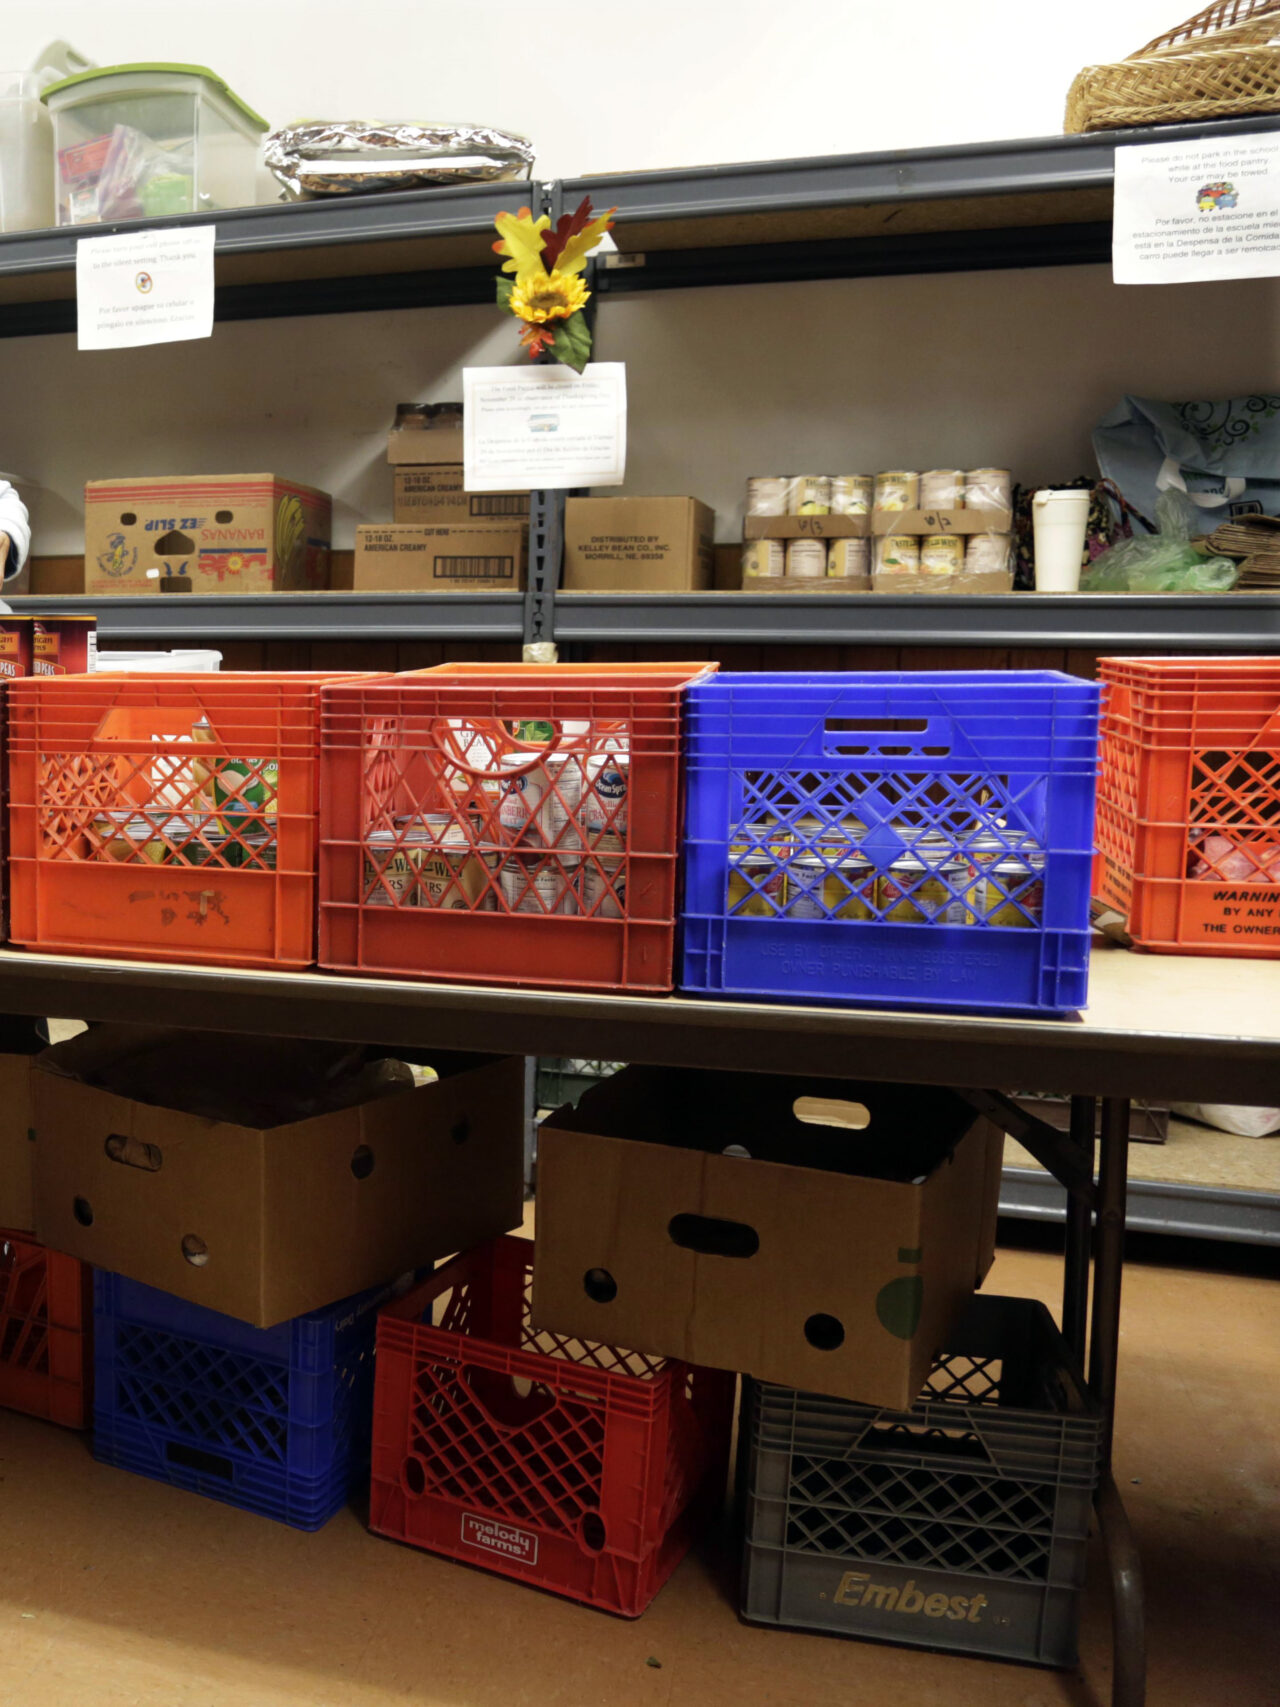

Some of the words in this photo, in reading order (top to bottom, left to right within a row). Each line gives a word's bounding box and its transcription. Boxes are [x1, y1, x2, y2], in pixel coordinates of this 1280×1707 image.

[1202, 151, 1221, 160] park
[1219, 159, 1239, 168] food
[1206, 172, 1225, 182] may
[1227, 170, 1239, 178] be
[1155, 218, 1170, 226] Por
[1198, 215, 1210, 223] no
[1211, 212, 1253, 222] estacione
[1256, 210, 1268, 218] en
[1270, 208, 1279, 217] el
[1132, 227, 1201, 239] estacionamiento
[1203, 225, 1214, 234] de
[1216, 224, 1224, 233] la
[1226, 222, 1260, 232] escuela
[1167, 239, 1174, 248] la
[1176, 237, 1219, 248] Despensa
[1221, 235, 1233, 244] de
[1235, 234, 1243, 243] la
[159, 254, 181, 263] Thank
[1162, 251, 1189, 261] puede
[1191, 249, 1214, 259] llegar
[404, 485, 436, 493] AMERICAN
[179, 517, 197, 530] EZ
[201, 528, 265, 541] BANANAS
[364, 543, 398, 552] AMERICAN
[399, 543, 427, 552] CREAMY
[0, 661, 16, 677] PEAS
[41, 661, 55, 676] PEAS
[611, 783, 628, 796] Spra
[1213, 891, 1280, 903] WARNIN
[1223, 907, 1241, 916] BY
[1247, 908, 1274, 918] ANY
[1203, 923, 1227, 933] THE
[468, 1520, 530, 1551] melody
[833, 1571, 988, 1623] Embest
